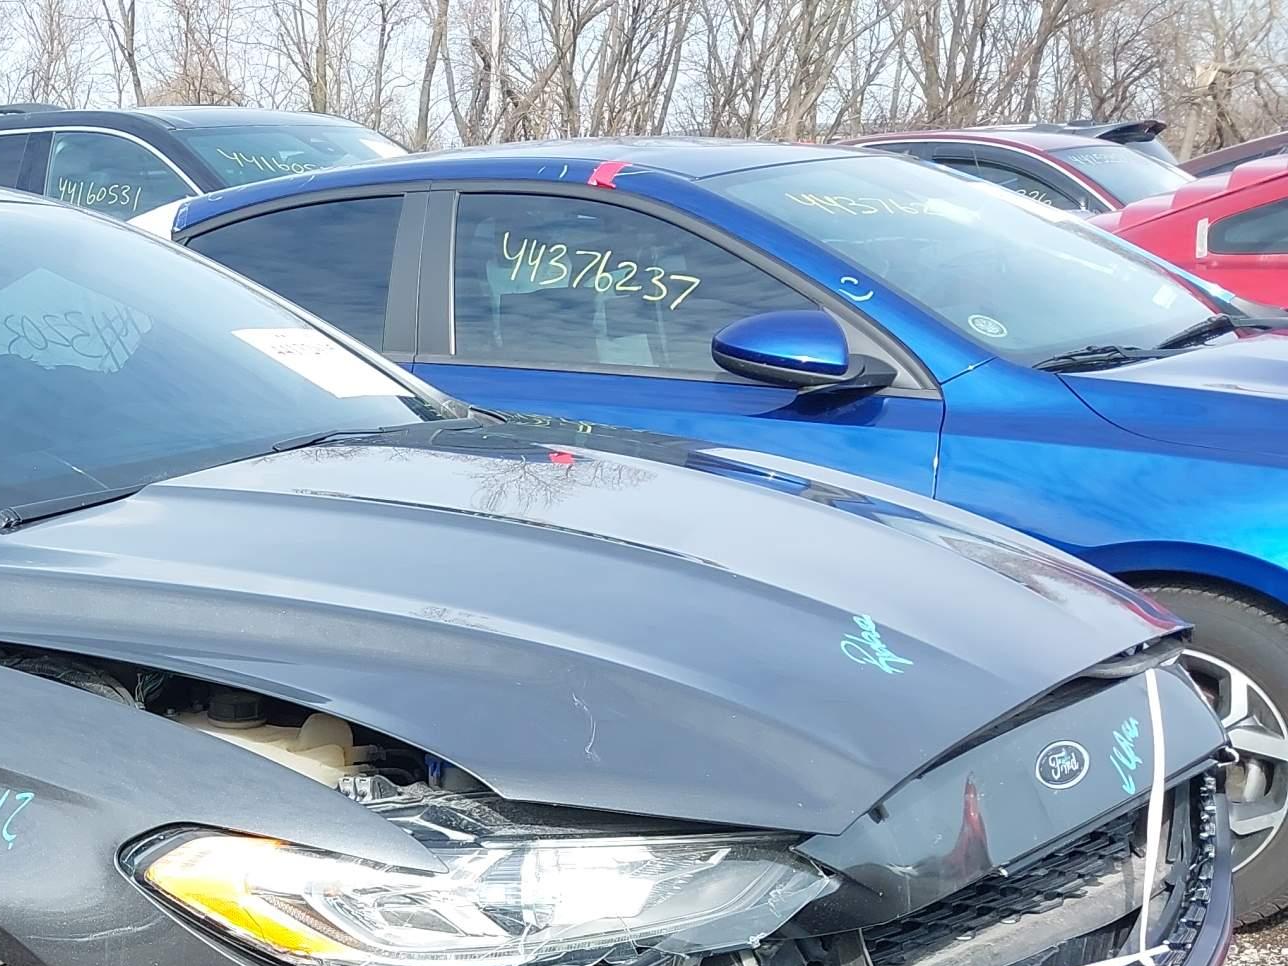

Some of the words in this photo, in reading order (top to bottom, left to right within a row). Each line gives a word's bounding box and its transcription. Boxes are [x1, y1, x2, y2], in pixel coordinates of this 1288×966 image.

[58, 178, 141, 211] 44160531
[503, 231, 701, 311] 44376237
[1048, 748, 1080, 780] Ford
